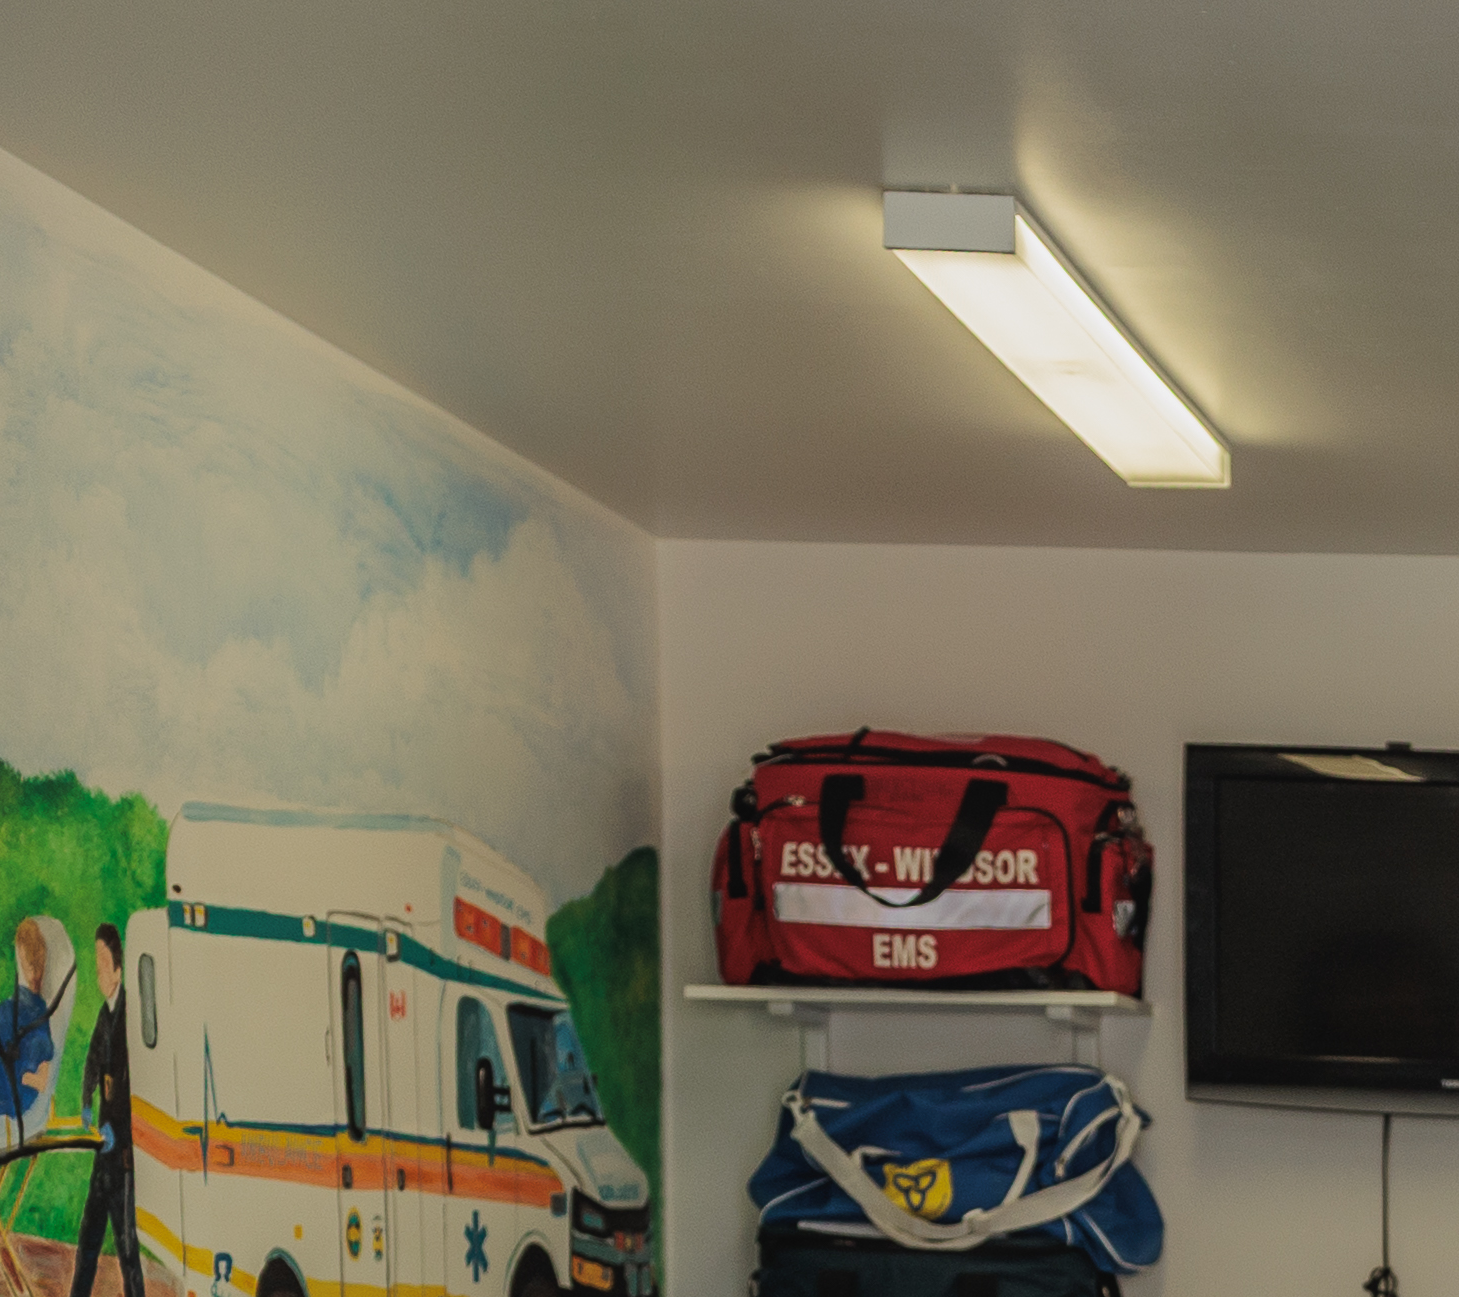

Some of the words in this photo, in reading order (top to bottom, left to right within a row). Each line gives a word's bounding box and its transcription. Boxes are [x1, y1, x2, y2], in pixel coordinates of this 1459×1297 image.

[781, 842, 871, 881] ESSX
[893, 846, 1039, 885] WISOR
[872, 933, 938, 969] EMS
